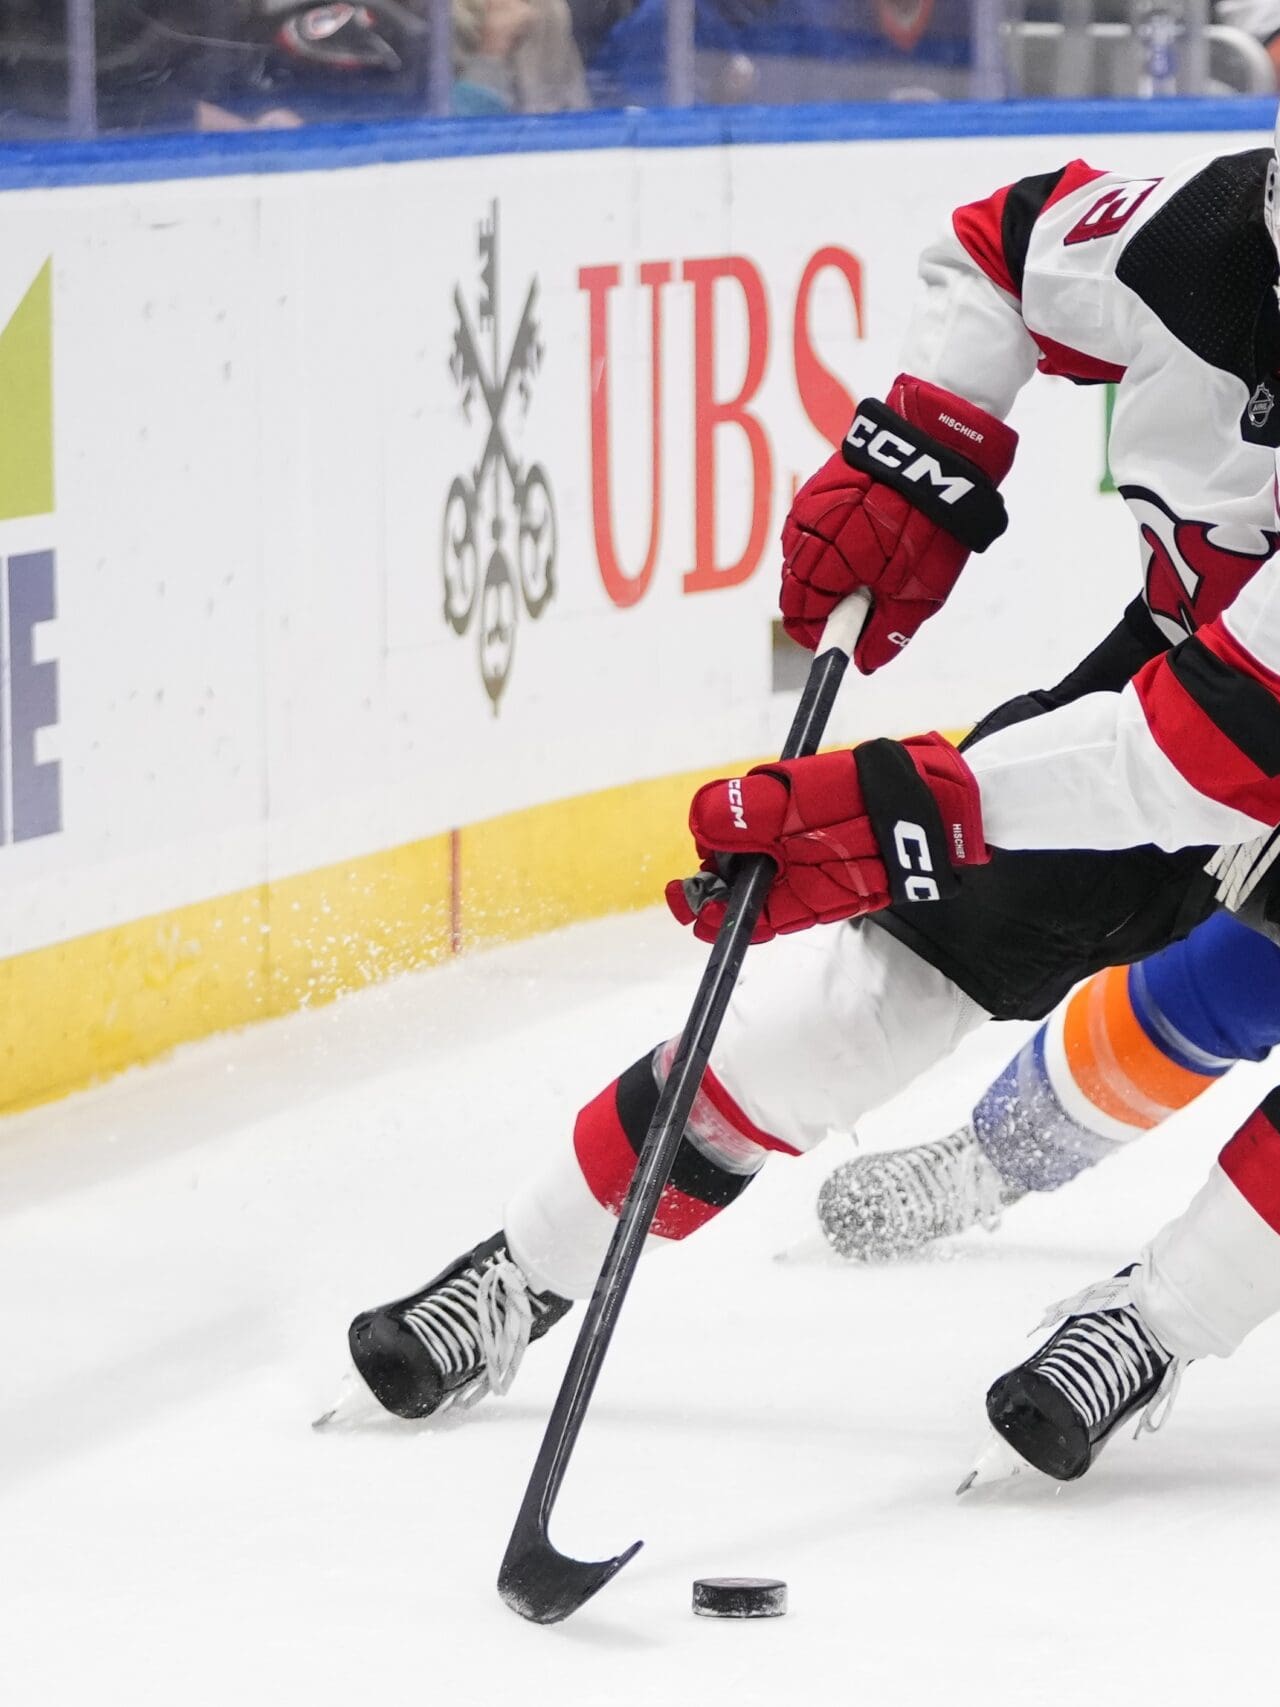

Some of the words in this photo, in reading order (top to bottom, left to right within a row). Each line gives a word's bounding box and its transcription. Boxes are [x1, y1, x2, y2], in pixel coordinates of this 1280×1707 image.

[578, 244, 865, 609] UBS
[938, 412, 986, 444] HISCHIER
[846, 414, 976, 505] CCM
[727, 778, 748, 830] CCM
[952, 823, 967, 860] HISCHIER
